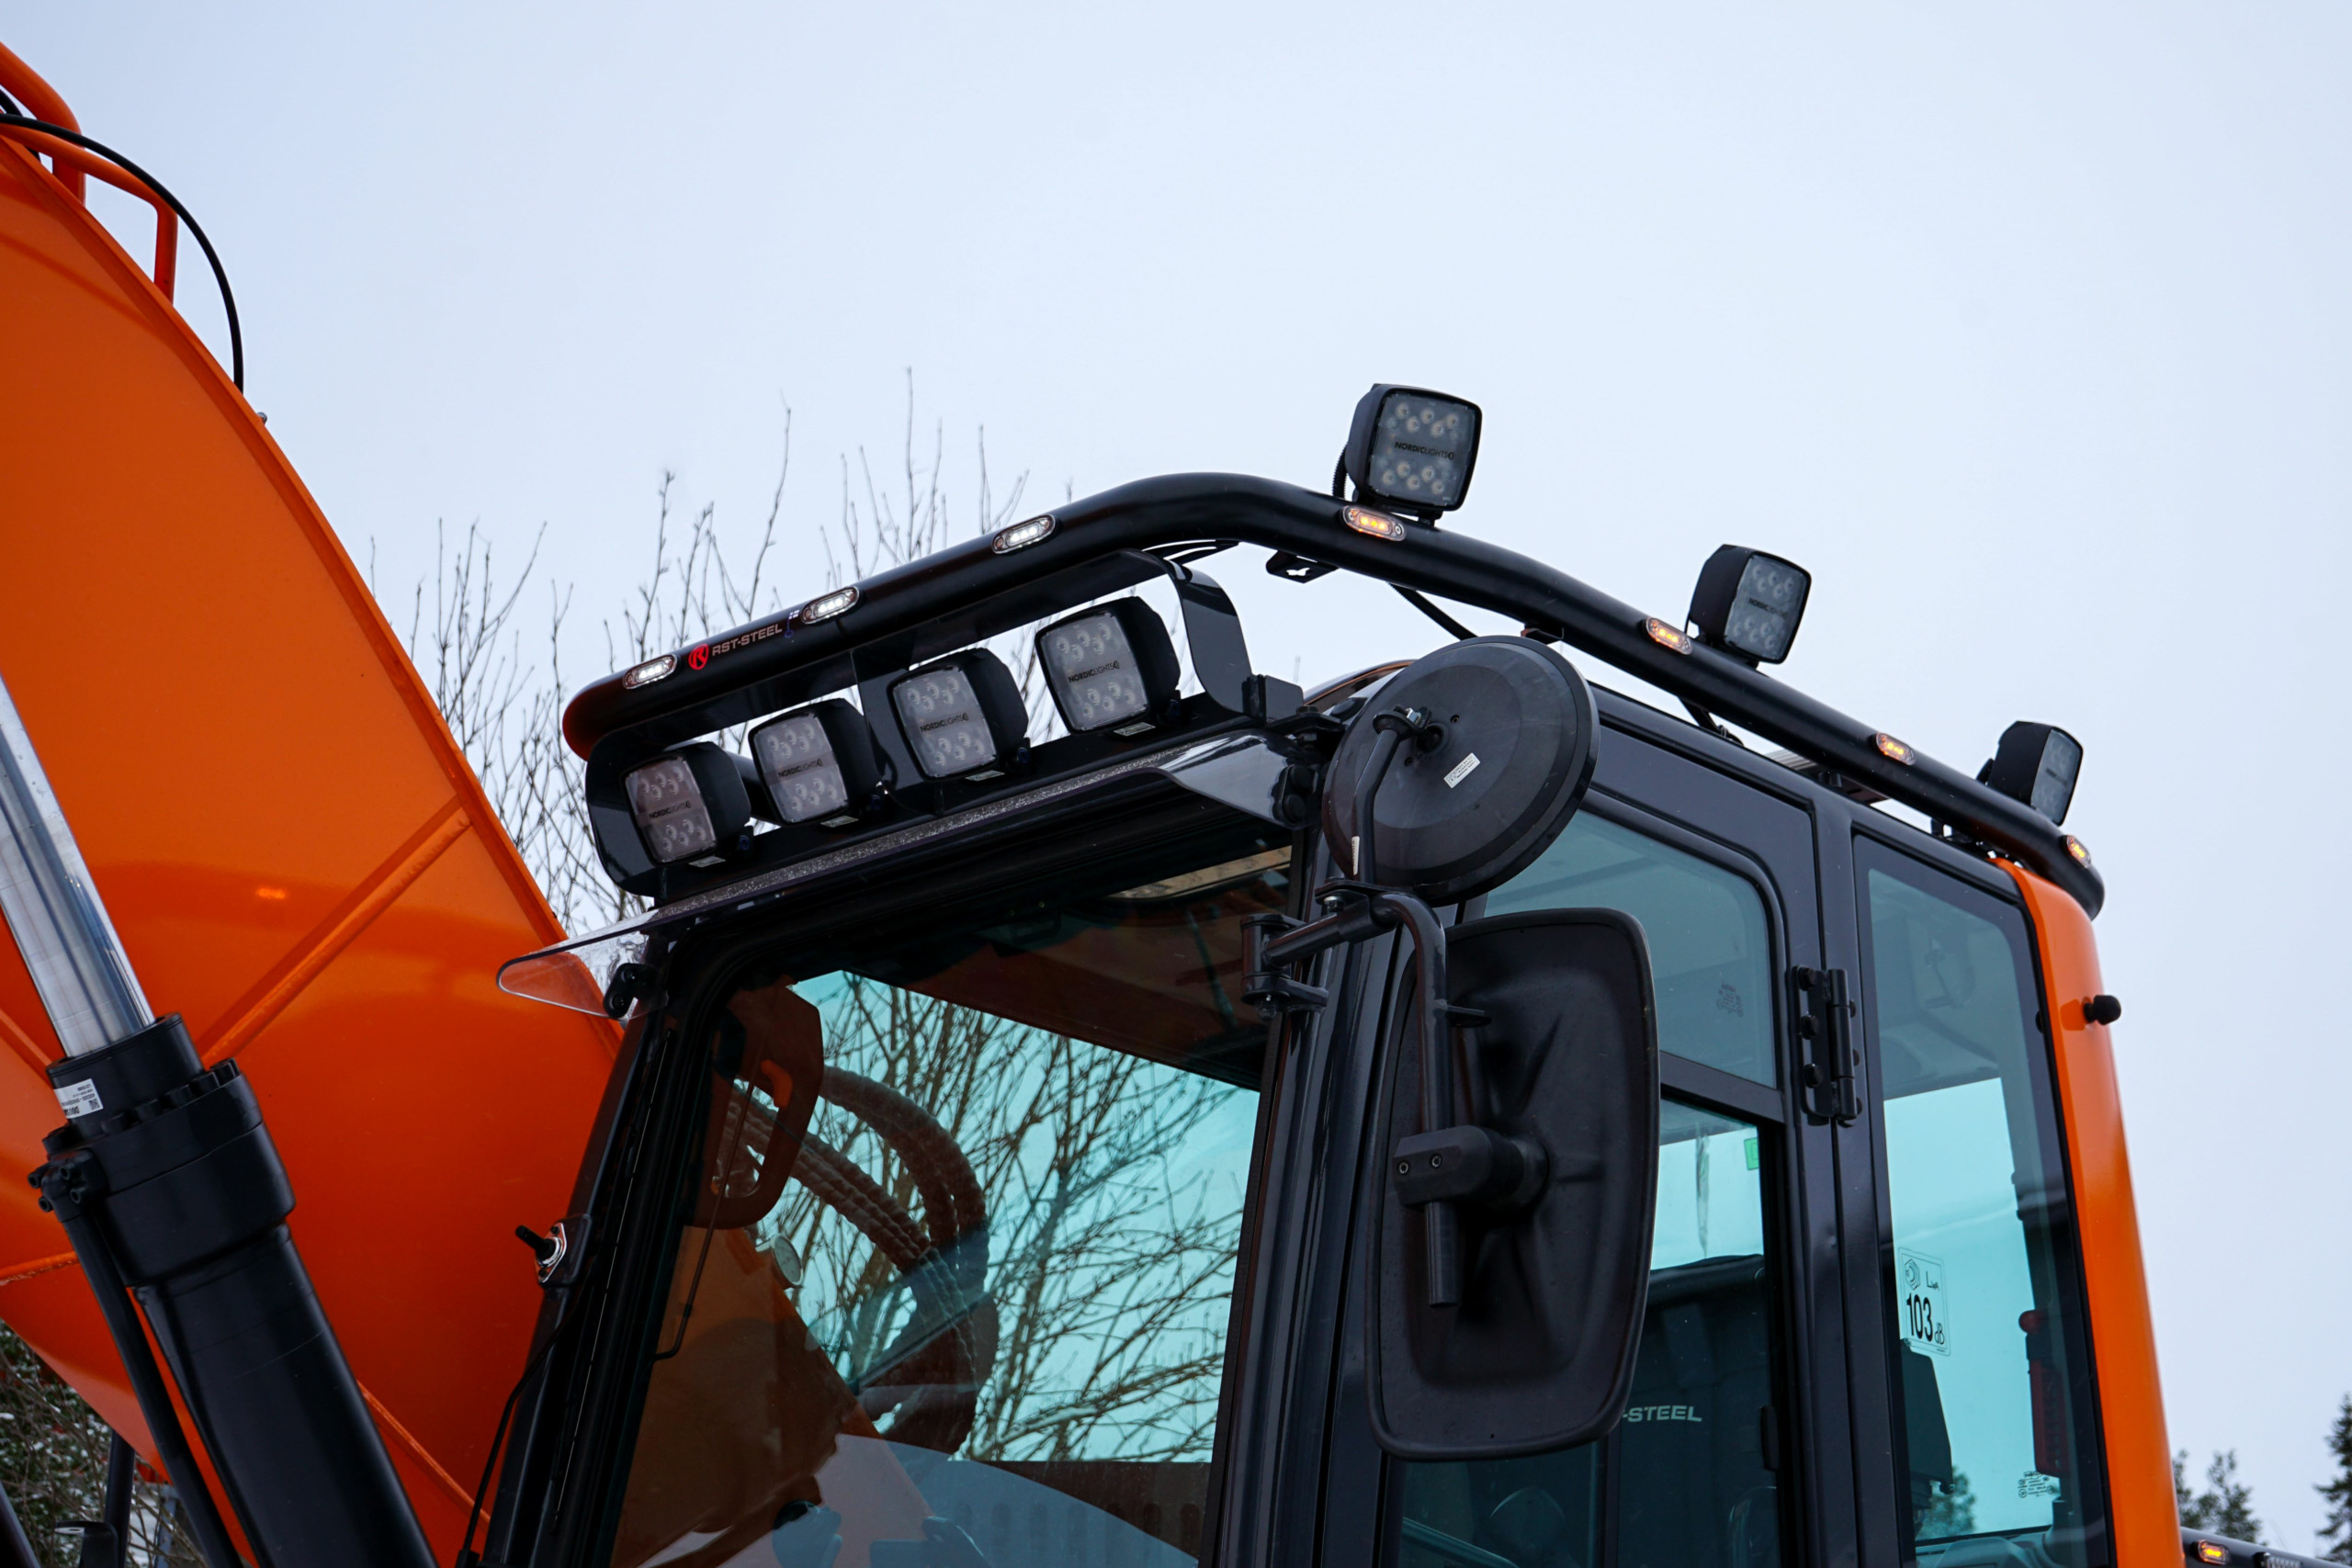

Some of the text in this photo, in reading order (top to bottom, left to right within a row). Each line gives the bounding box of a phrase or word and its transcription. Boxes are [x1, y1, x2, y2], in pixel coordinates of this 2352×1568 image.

[712, 624, 783, 656] RST-STEEL
[1068, 663, 1114, 683] NORDICLIGHTS
[1906, 1292, 1933, 1342] 103
